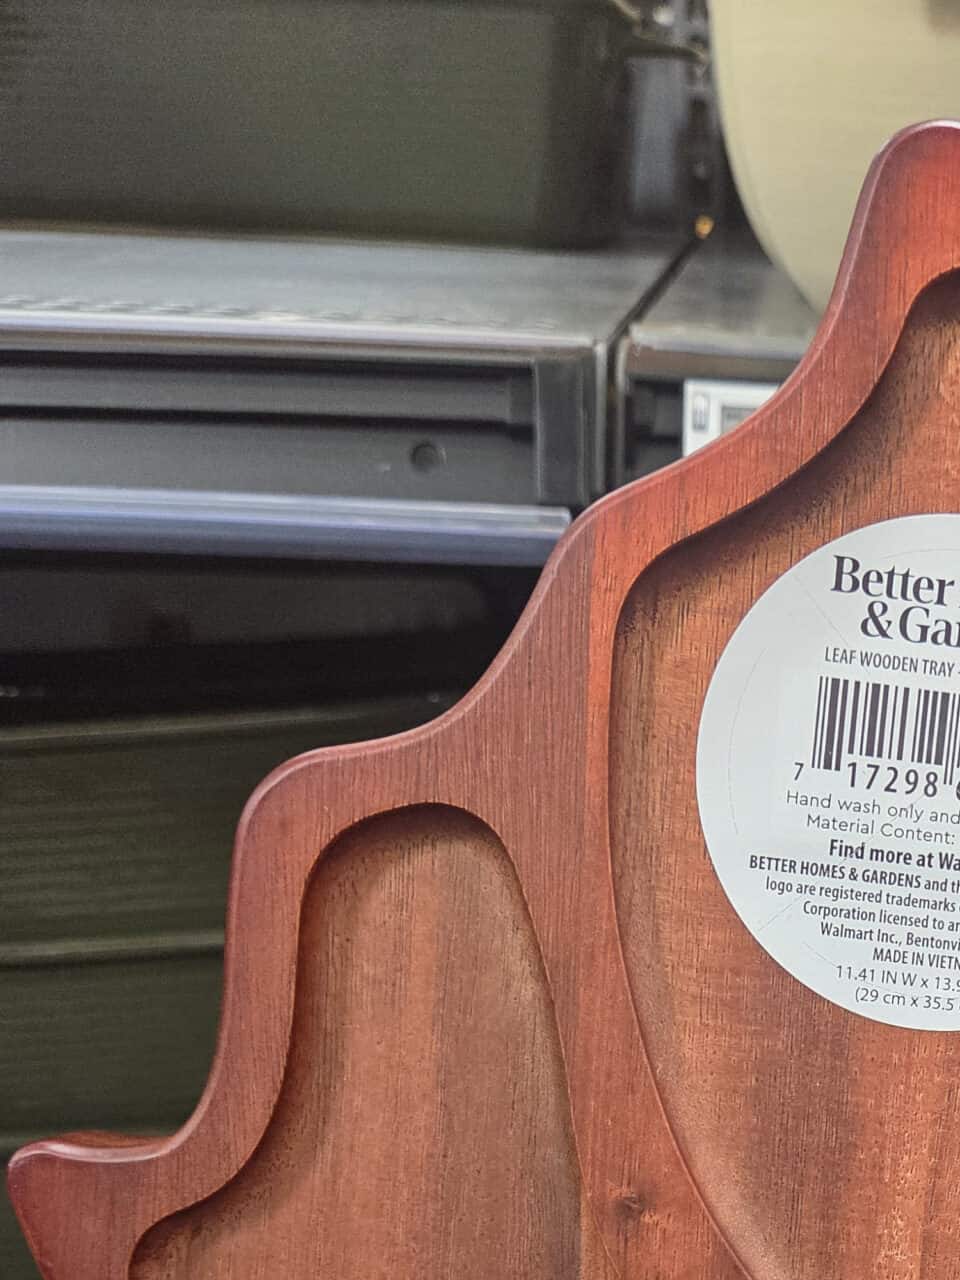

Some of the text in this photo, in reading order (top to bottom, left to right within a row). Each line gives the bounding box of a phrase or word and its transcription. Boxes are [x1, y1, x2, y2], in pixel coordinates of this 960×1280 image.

[830, 554, 956, 606] Better
[825, 646, 857, 664] LEAF
[860, 650, 919, 673] WOODEN
[922, 658, 955, 677] TRAY
[794, 761, 805, 780] 7
[847, 761, 939, 797] 17298
[786, 789, 832, 808] Hand
[837, 799, 881, 815] wash
[887, 803, 925, 823] only
[807, 813, 875, 834] Material
[880, 822, 956, 845] Content:
[829, 838, 866, 860] Find
[869, 847, 913, 865] more
[916, 852, 935, 868] at
[749, 854, 797, 874] BETTER
[800, 860, 846, 879] HOMES
[848, 867, 859, 881] &
[861, 868, 922, 888] GARDENS
[924, 878, 949, 892] and
[766, 875, 793, 895] logo
[796, 883, 817, 895] are
[819, 885, 883, 903] registered
[886, 892, 957, 912] trademarks
[803, 900, 876, 922] Corporation
[879, 908, 930, 928] licensed
[932, 917, 945, 930] to
[820, 921, 874, 941] Walmart
[877, 928, 902, 946] Inc.,
[872, 947, 909, 964] MADE
[911, 951, 925, 966] IN
[836, 965, 875, 982] 11.41
[881, 969, 898, 984] IN
[902, 972, 918, 986] W
[920, 977, 929, 988] x
[855, 986, 879, 1002] (29
[883, 993, 906, 1006] cm
[910, 996, 919, 1007] x
[923, 995, 955, 1011] 35.5
